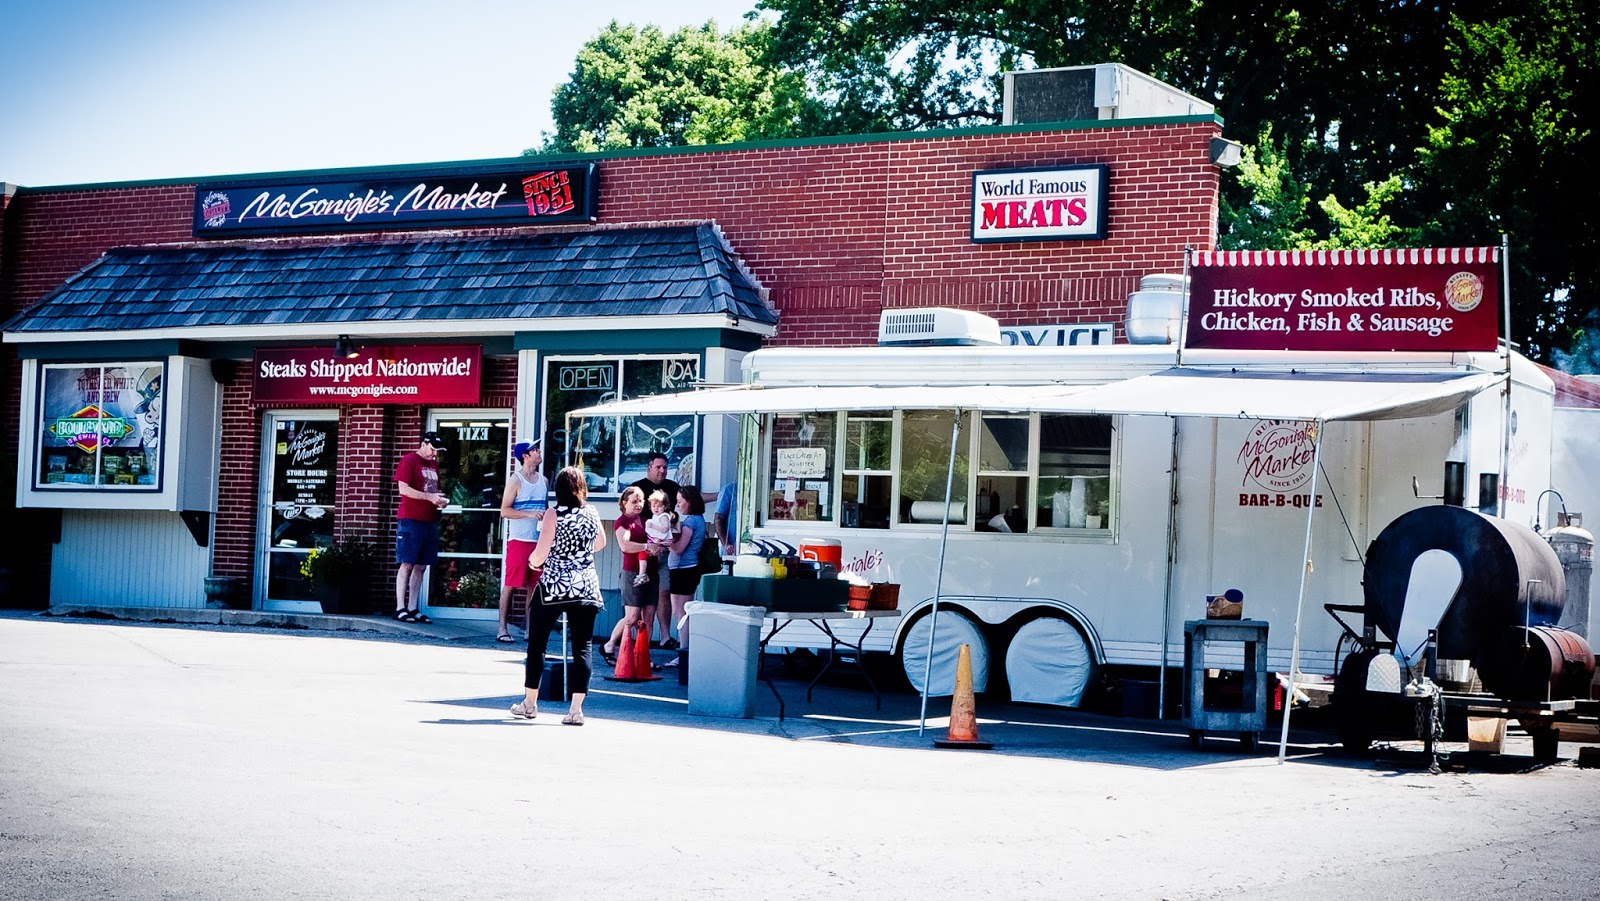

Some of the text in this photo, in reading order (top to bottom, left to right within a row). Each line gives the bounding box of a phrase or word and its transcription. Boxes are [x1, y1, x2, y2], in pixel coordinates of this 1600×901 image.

[524, 170, 570, 198] SINCE
[981, 178, 1087, 197] World Famous
[239, 182, 507, 222] McGonigle's Market
[526, 184, 574, 216] 1951
[980, 198, 1088, 230] MEATS
[1213, 286, 1442, 313] Hickory Smoked Ribs,
[1201, 312, 1454, 336] Chicken, Fish & Sausage
[260, 357, 472, 382] Steaks Shipped Nationwide!
[562, 367, 611, 388] OPEN
[309, 383, 418, 397] www.mcgonigles.com
[67, 434, 99, 445] BREWIN
[292, 441, 325, 466] Market
[286, 469, 328, 477] STORE HOURS
[1269, 472, 1307, 487] SINCE 1951
[1238, 493, 1323, 509] BAR-B-QUE
